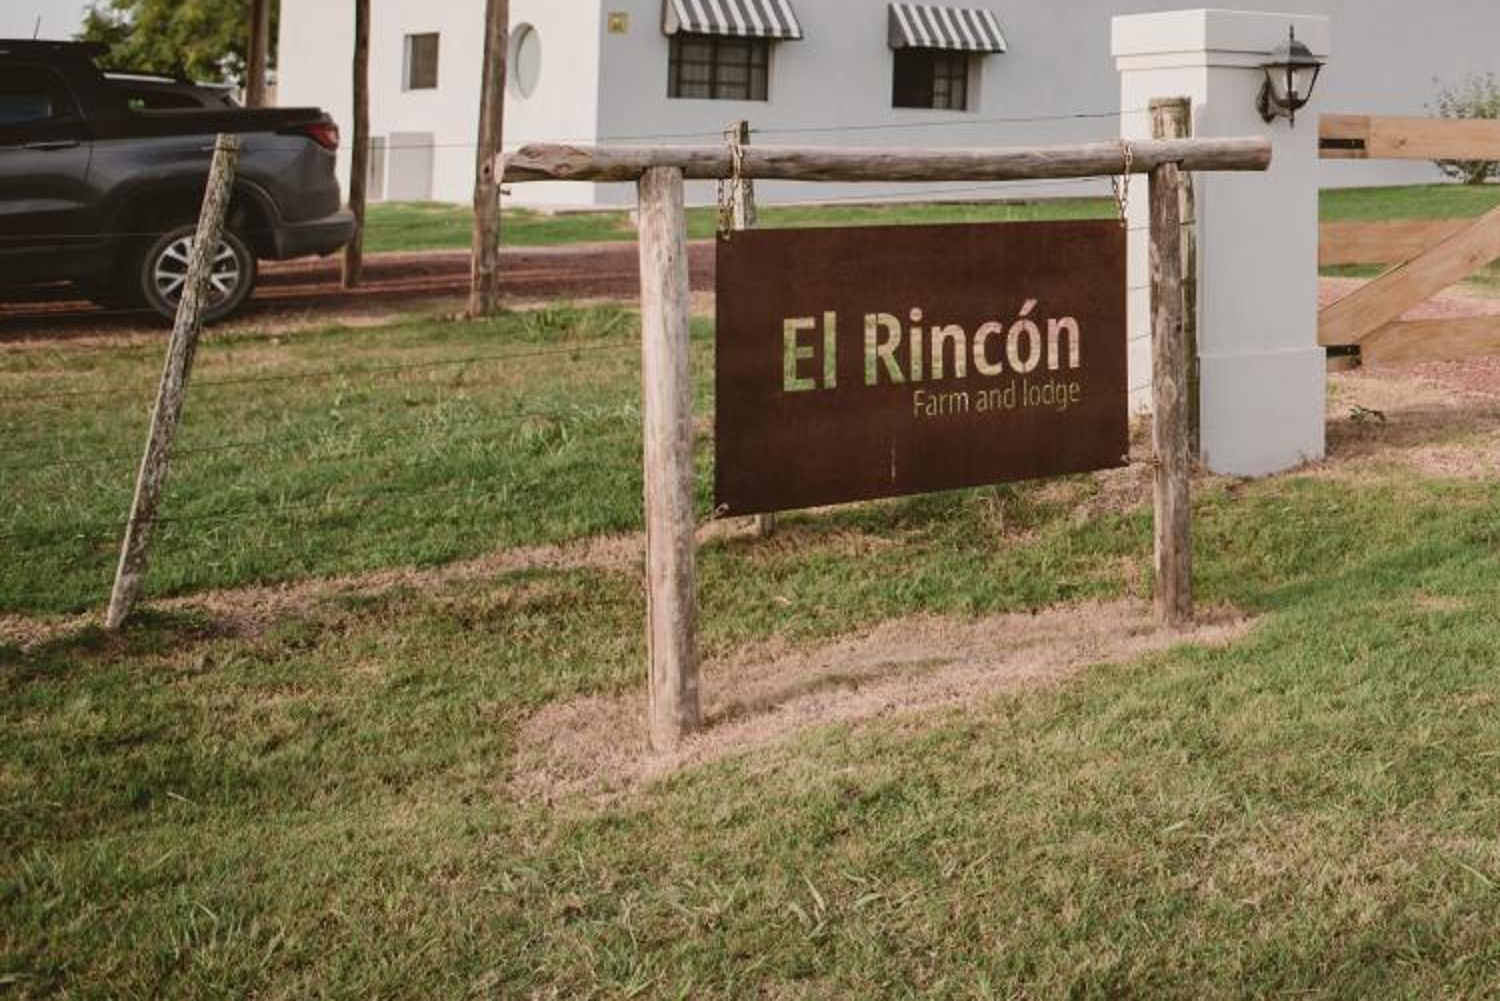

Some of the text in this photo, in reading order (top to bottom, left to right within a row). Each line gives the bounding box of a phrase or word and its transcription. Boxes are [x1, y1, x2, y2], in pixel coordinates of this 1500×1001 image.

[782, 299, 1081, 392] El Rincón
[913, 378, 1081, 417] Farm and lodge
